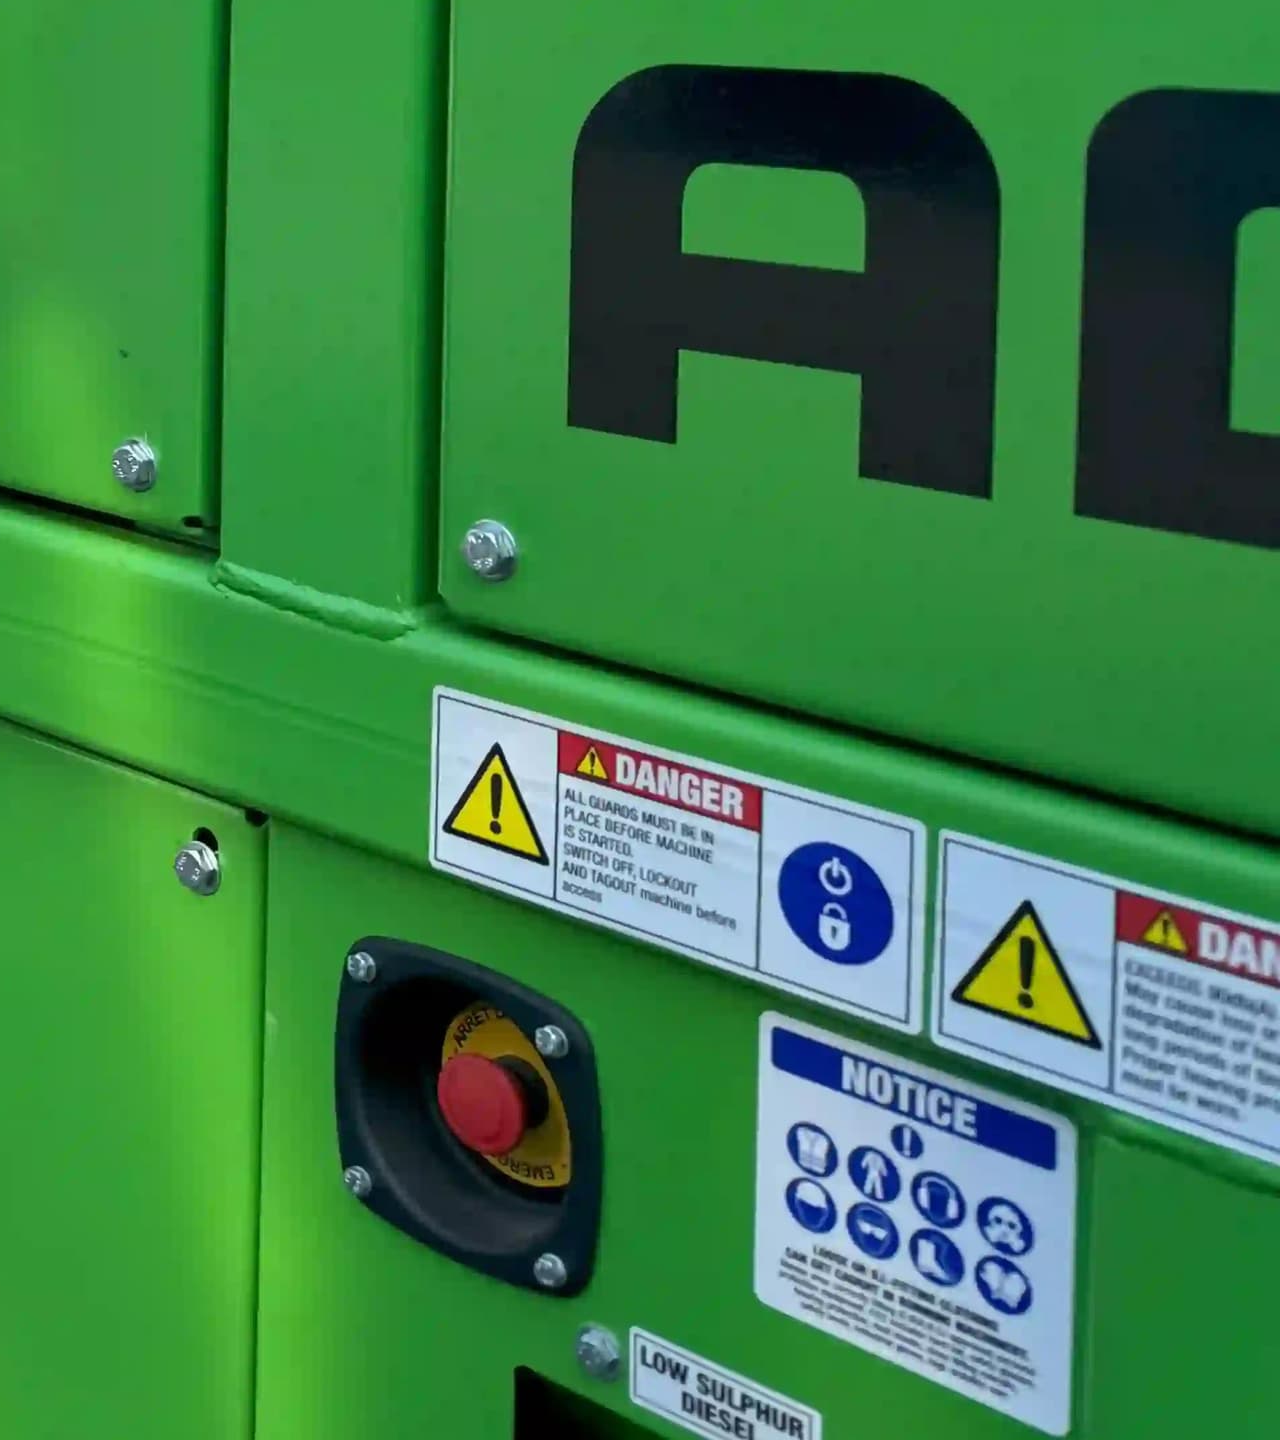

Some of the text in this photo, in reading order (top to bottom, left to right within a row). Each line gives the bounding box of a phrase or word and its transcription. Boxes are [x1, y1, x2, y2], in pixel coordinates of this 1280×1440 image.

[615, 752, 744, 820] DANGER
[564, 788, 714, 845] ALL GUARDS MUST BE IN
[564, 824, 575, 837] IS
[564, 806, 713, 864] PLACE BEFORE MACHINE
[563, 862, 587, 880] AND
[592, 869, 636, 896] TAGOUT
[640, 887, 692, 914] machine
[564, 843, 609, 866] SWITCH
[640, 867, 698, 897] LOCKOUT
[841, 1055, 977, 1139] NOTICE
[641, 1345, 804, 1440] LOW SULPHUR
